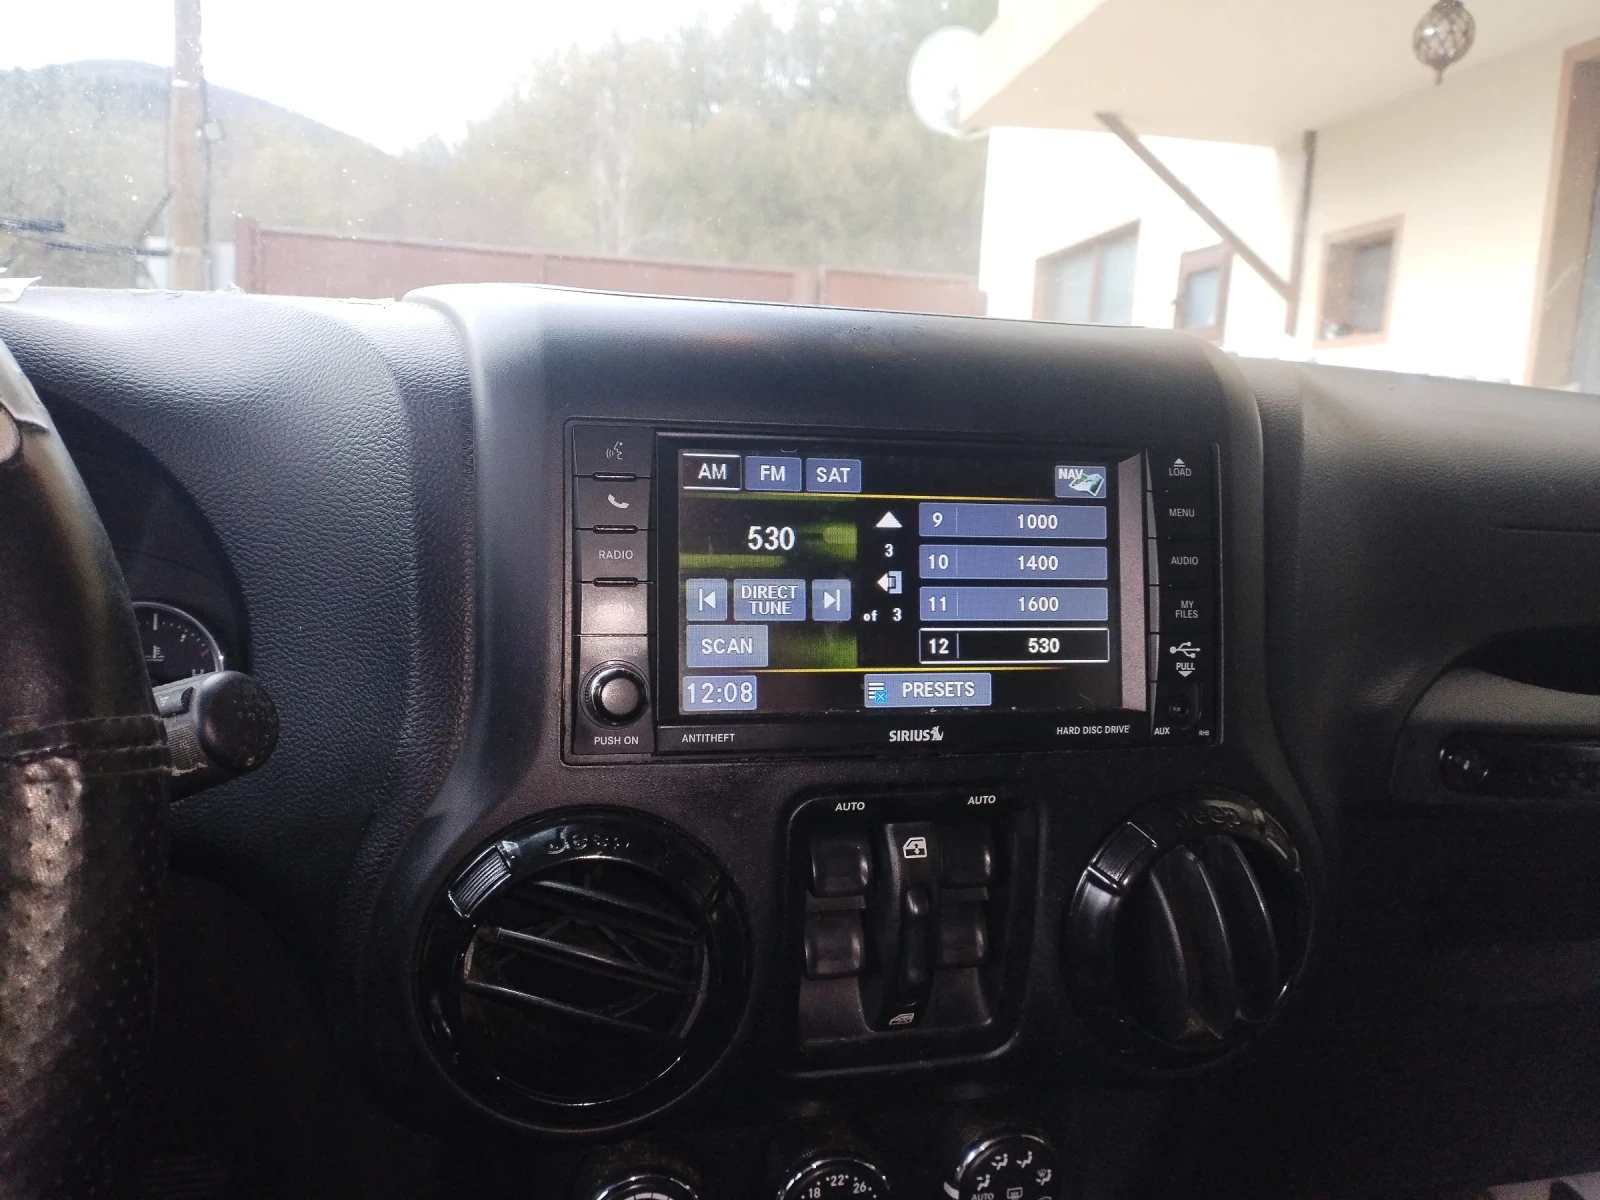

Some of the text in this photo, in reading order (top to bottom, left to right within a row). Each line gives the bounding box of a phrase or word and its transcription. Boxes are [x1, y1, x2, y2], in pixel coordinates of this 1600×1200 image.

[698, 463, 727, 480] AM
[760, 465, 786, 482] FM
[816, 467, 851, 483] SAT
[1058, 468, 1084, 480] NAV
[1168, 467, 1192, 477] LOAD
[1169, 508, 1196, 517] MENU
[932, 512, 943, 528] 9
[1017, 513, 1059, 530] 1000
[747, 525, 796, 551] 530
[598, 549, 634, 560] RADIO
[884, 544, 894, 558] 3
[928, 554, 949, 570] 10
[1018, 555, 1059, 571] 1400
[1171, 556, 1199, 566] AUDIO
[741, 584, 799, 600] DIRECT
[749, 600, 793, 616] TUNE
[929, 596, 948, 612] 11
[1018, 596, 1060, 613] 1600
[1180, 600, 1195, 609] MY
[863, 609, 903, 622] of 3
[1175, 609, 1199, 619] FILES
[701, 638, 754, 655] SCAN
[929, 638, 950, 655] 12
[1028, 637, 1061, 654] 530
[1175, 662, 1196, 671] PULL
[686, 681, 754, 703] 12:08
[902, 681, 976, 699] PRESETS
[889, 729, 931, 743] SIRIUS
[1056, 725, 1130, 736] HARD DISC DRIVE
[1154, 726, 1171, 736] AUX
[594, 735, 640, 746] PUSH ON
[681, 733, 736, 744] ANTITHEFT
[835, 801, 866, 812] AUTO
[967, 794, 997, 806] AUTO
[830, 1174, 845, 1187] 22
[808, 1187, 822, 1199] 18
[853, 1181, 868, 1194] 26
[971, 1192, 995, 1200] AUTO
